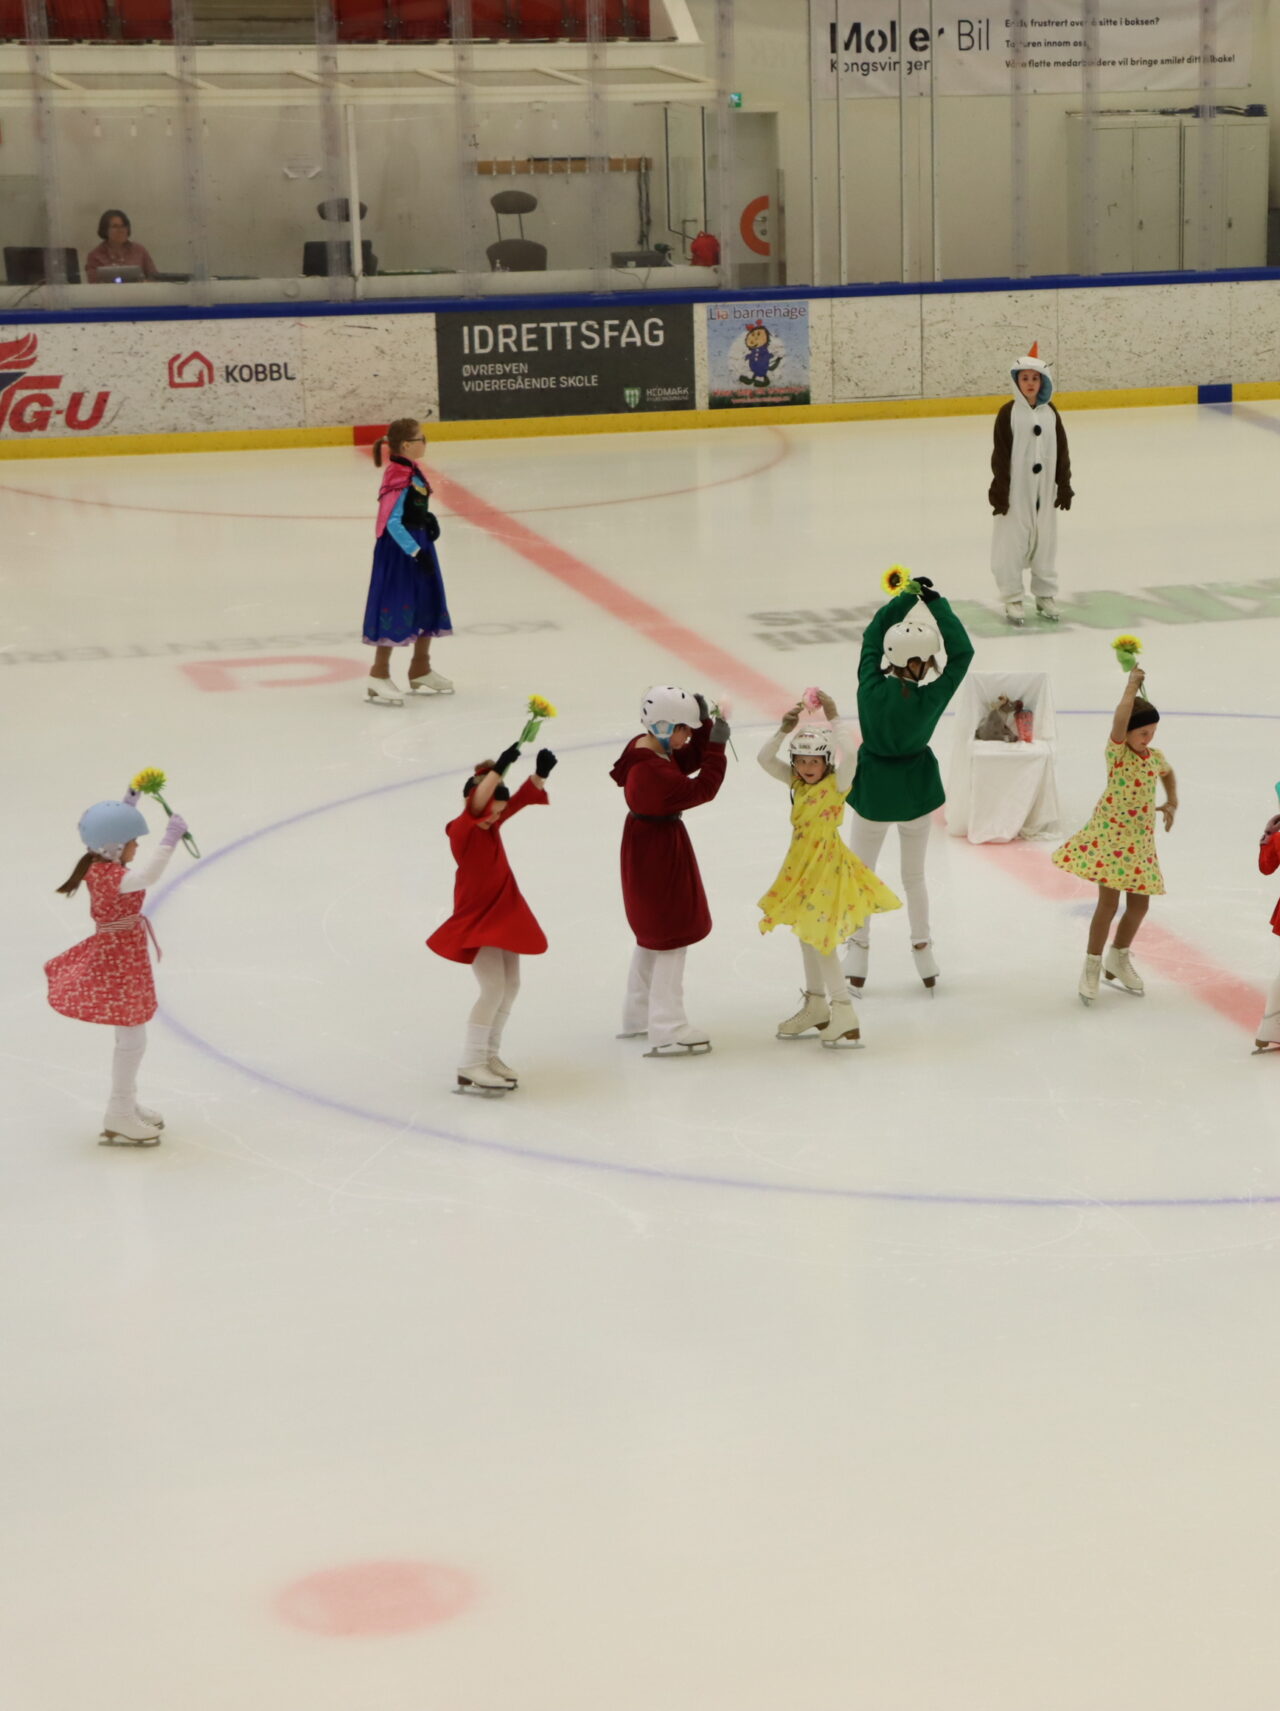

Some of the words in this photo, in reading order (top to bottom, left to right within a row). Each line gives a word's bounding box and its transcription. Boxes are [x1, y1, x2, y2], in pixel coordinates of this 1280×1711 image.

[1030, 18, 1068, 28] frustrert
[1099, 17, 1118, 26] sitte
[1125, 16, 1159, 26] boksen?
[957, 18, 990, 51] Bil
[1044, 38, 1071, 48] innom
[1028, 58, 1051, 69] flotte
[1118, 57, 1129, 66] vil
[1130, 56, 1159, 67] bringe
[1160, 55, 1185, 65] smilet
[1186, 54, 1201, 64] ditt
[708, 308, 729, 320] Lia
[733, 305, 807, 320] barnehage
[462, 318, 665, 354] IDRETTSFAG
[224, 362, 296, 384] KOBBL
[462, 362, 529, 377] ØVREBYEN
[462, 375, 557, 392] VIDEREGÅENDE
